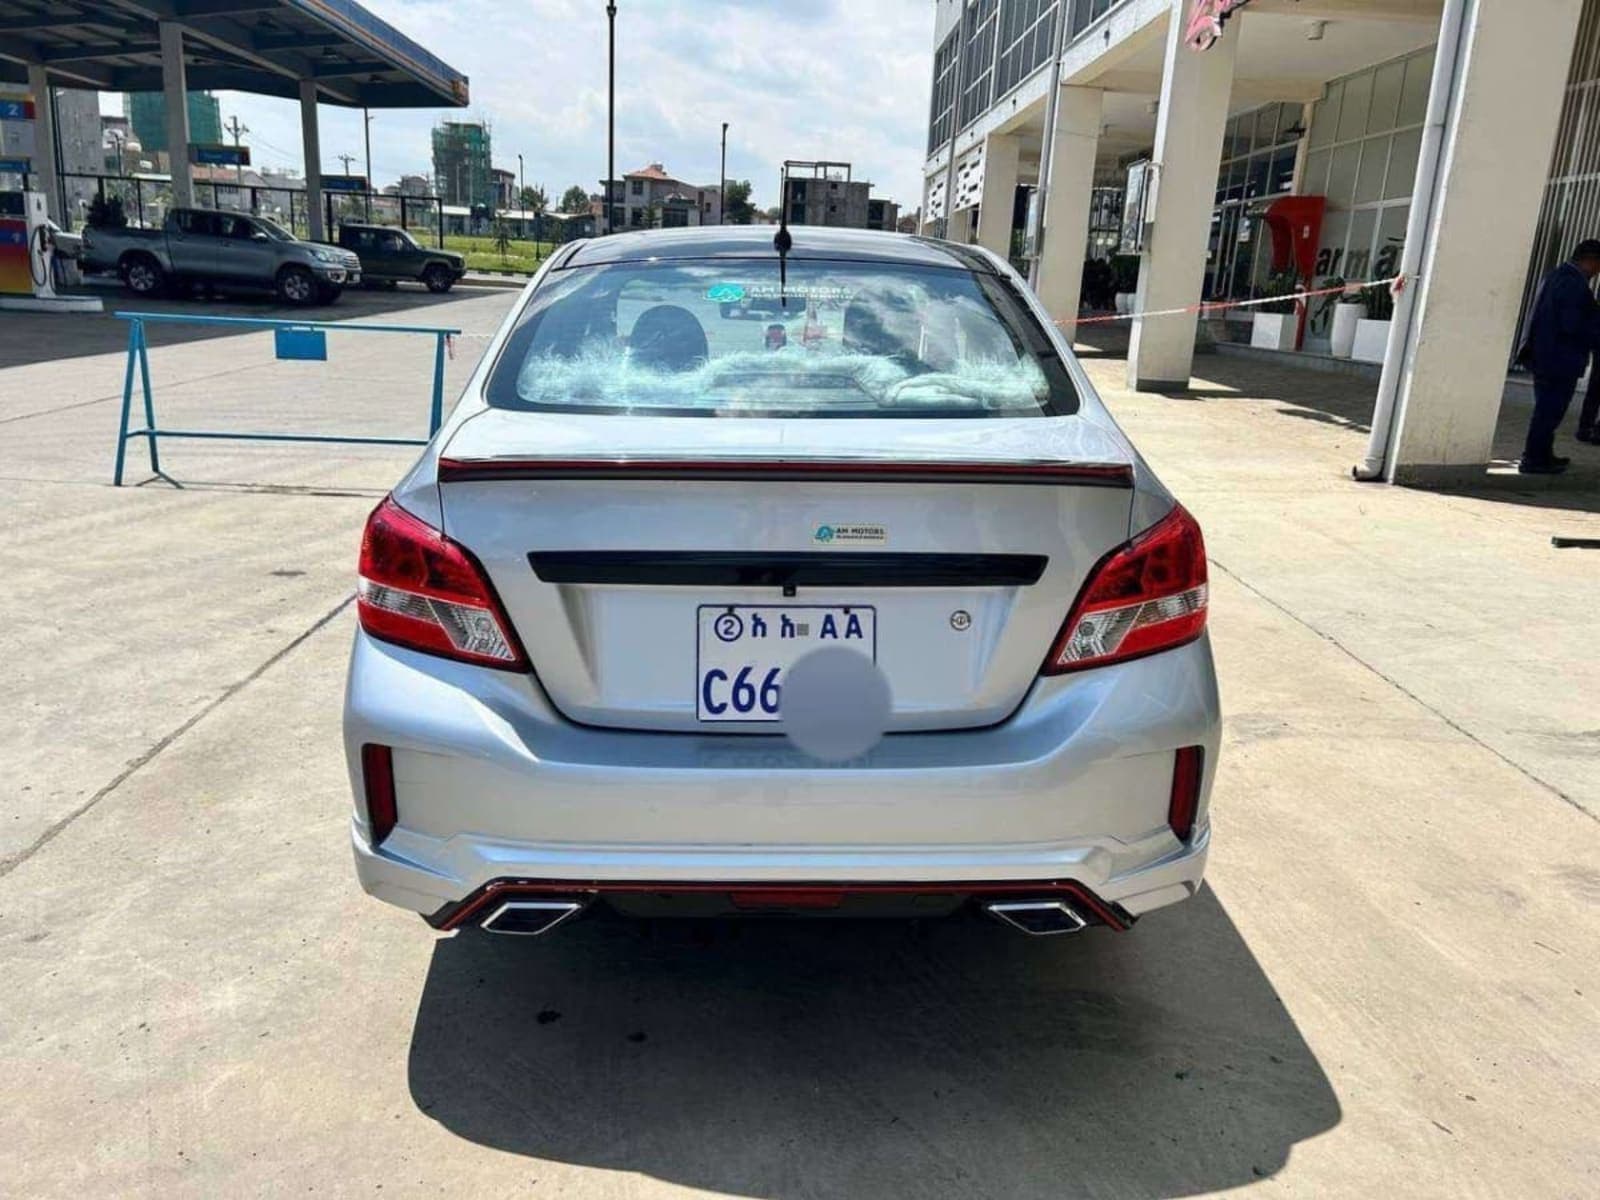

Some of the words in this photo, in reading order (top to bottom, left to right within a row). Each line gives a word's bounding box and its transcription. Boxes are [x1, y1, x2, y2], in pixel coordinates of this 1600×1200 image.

[7, 103, 19, 116] 2
[1316, 245, 1401, 281] arma
[851, 527, 884, 535] MOTORS
[702, 666, 782, 715] C66
